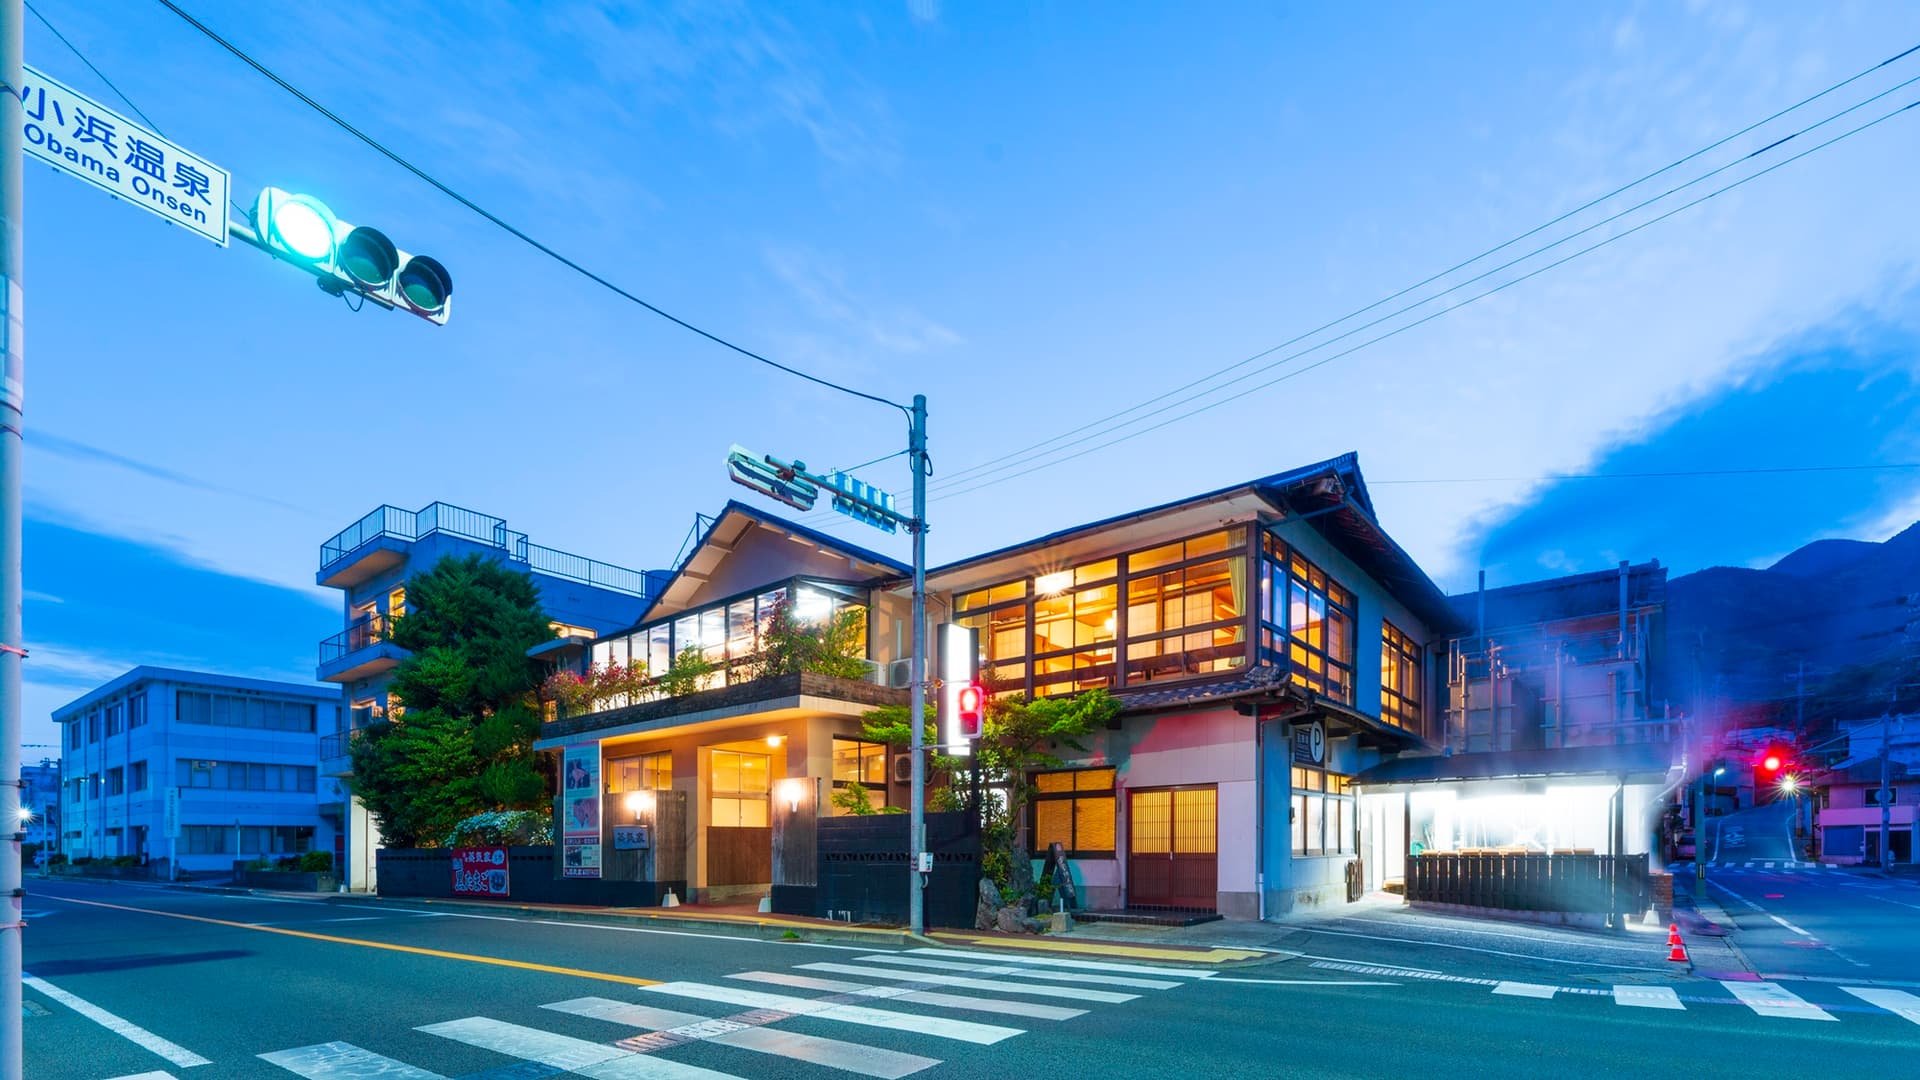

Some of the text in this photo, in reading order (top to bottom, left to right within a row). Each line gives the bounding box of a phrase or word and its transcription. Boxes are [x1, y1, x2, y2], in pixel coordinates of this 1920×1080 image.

[22, 86, 211, 206] 小浜温泉
[24, 123, 206, 224] Obama Onsen
